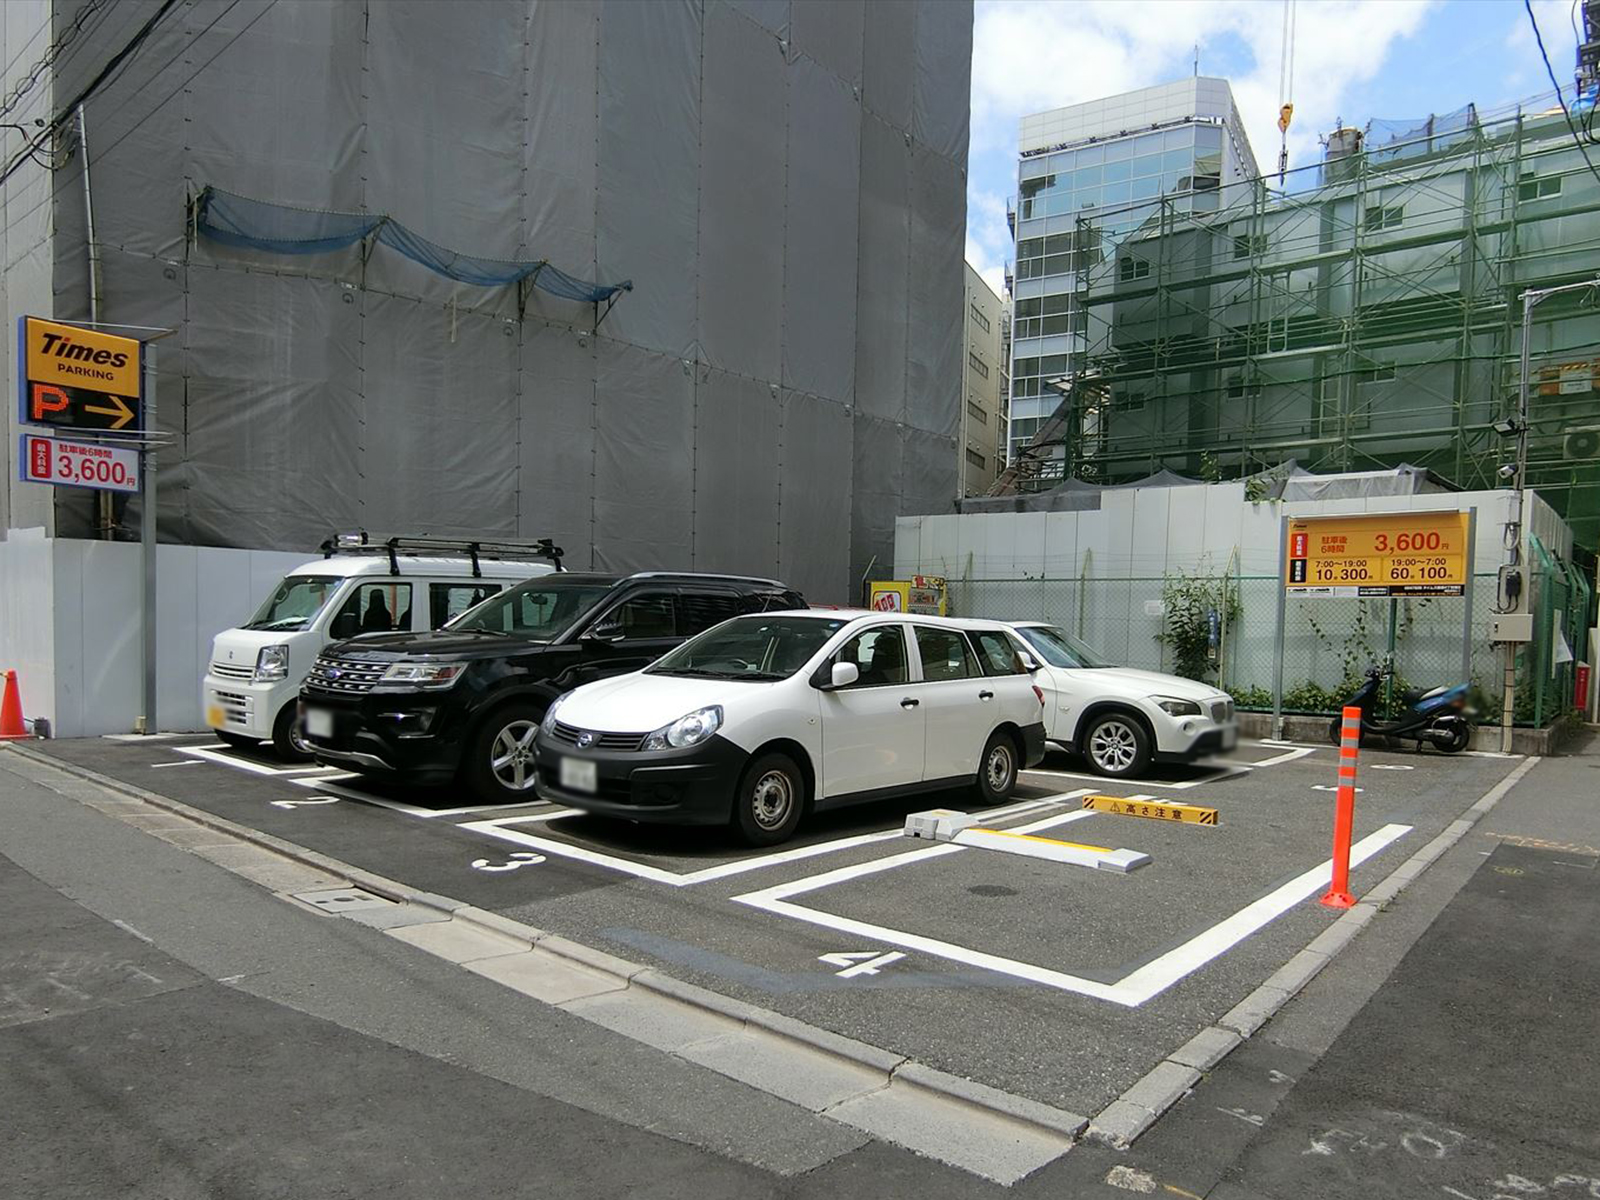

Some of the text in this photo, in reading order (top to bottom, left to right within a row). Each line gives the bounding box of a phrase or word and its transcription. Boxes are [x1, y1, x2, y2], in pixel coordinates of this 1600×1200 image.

[41, 333, 128, 368] Times
[58, 363, 114, 381] PARKING
[33, 383, 69, 419] P
[1126, 803, 1182, 820] 高さ注意
[471, 852, 546, 871] 3
[817, 951, 906, 978] 4
